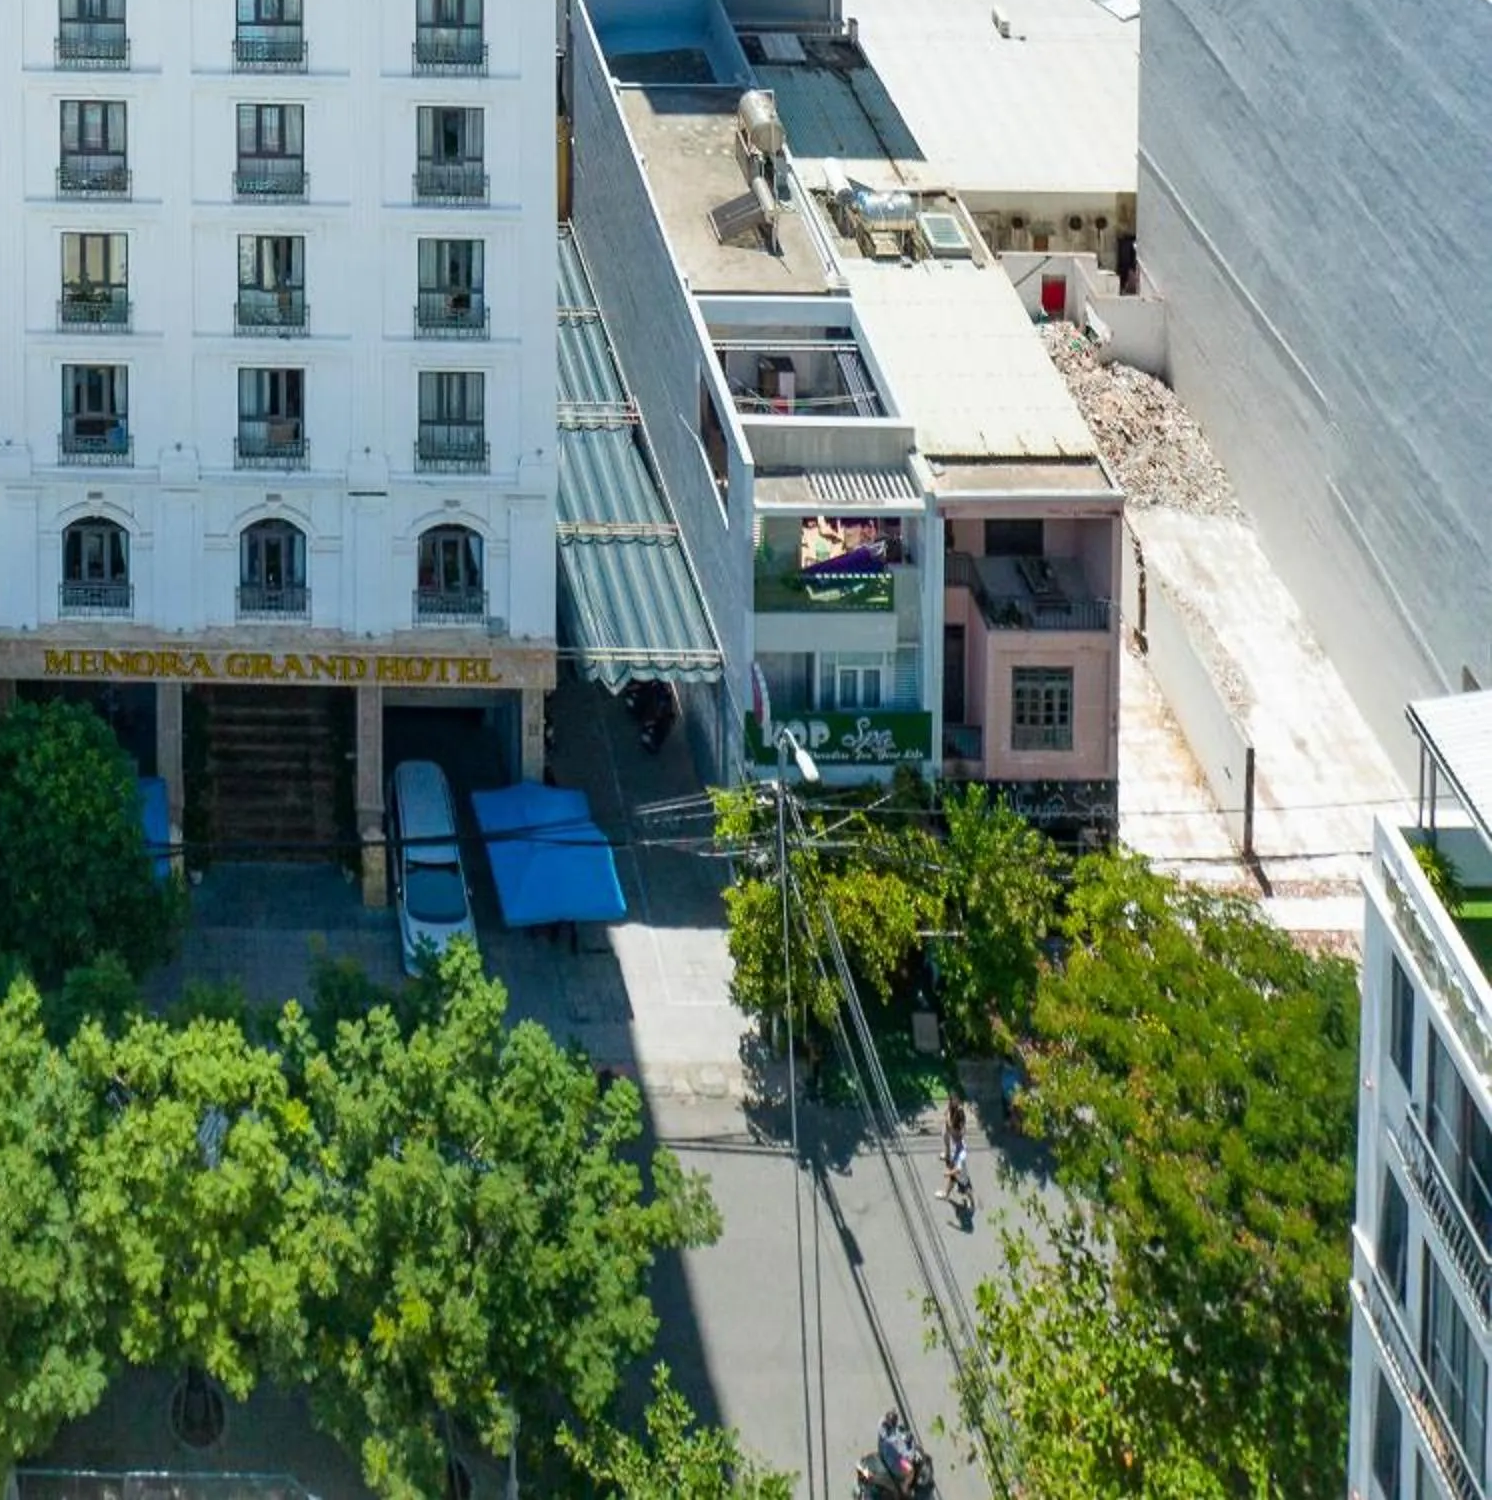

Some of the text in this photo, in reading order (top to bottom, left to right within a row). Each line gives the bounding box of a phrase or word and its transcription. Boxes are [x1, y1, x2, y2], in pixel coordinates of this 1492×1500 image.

[43, 649, 503, 684] MENORA GRAND HOTEL
